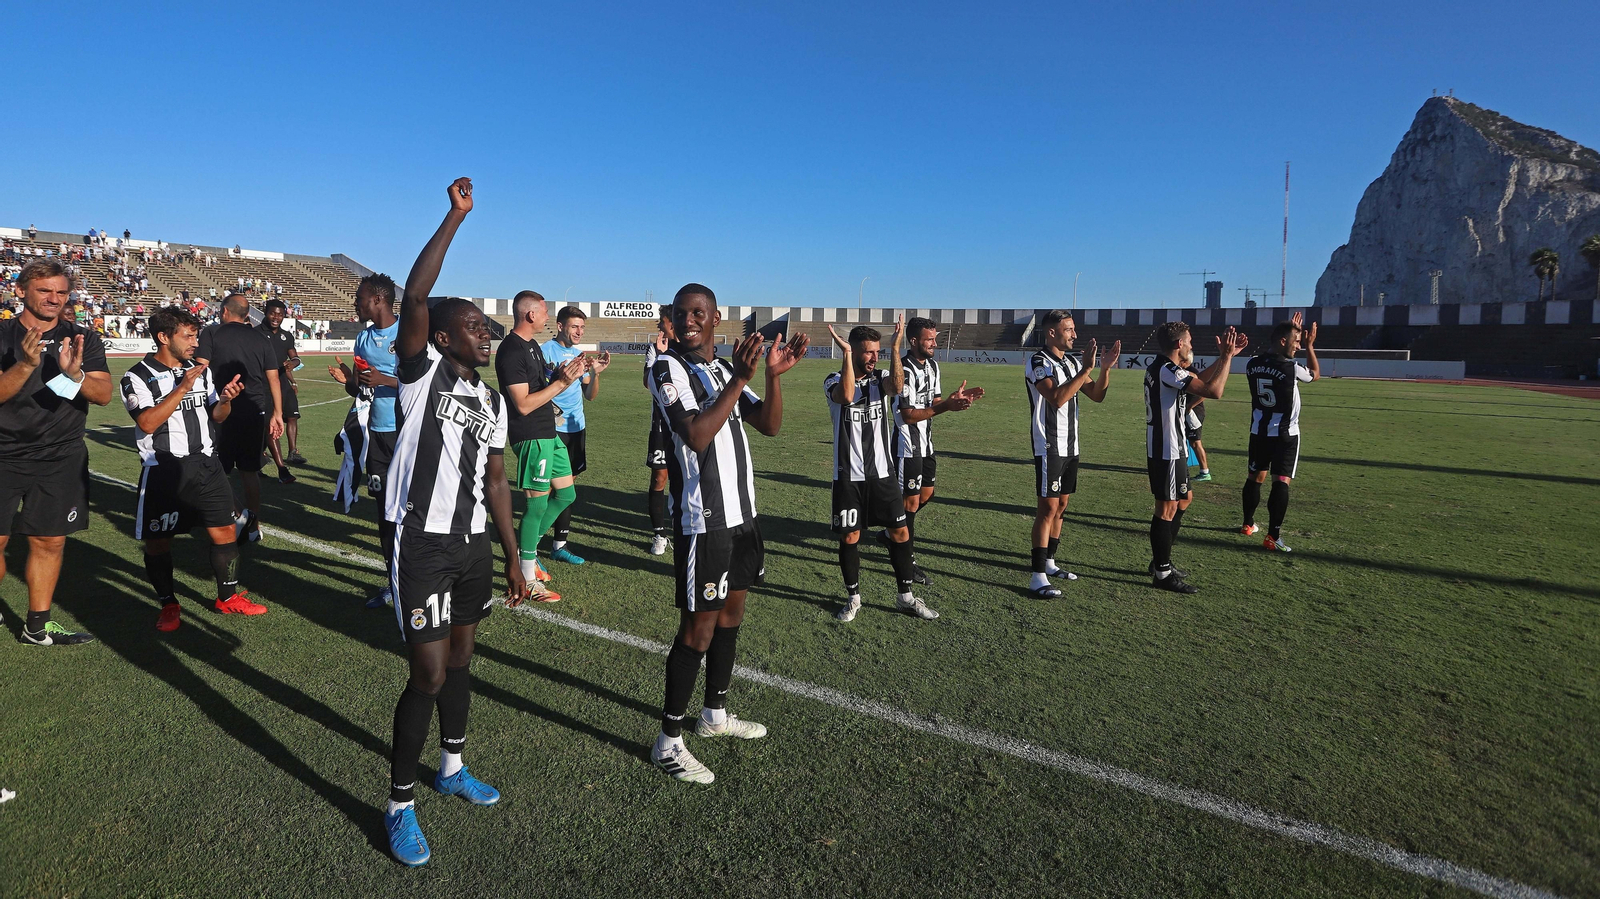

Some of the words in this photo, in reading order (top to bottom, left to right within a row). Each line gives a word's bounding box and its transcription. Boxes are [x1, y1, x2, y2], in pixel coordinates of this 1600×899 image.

[603, 310, 654, 318] GALLARDO
[606, 302, 653, 310] ALFREDO
[1256, 377, 1277, 408] 5
[844, 407, 883, 423] LOTUS
[538, 458, 547, 477] 1
[916, 474, 923, 490] 3
[161, 511, 179, 532] 19
[840, 508, 858, 528] 10
[717, 570, 729, 600] 6
[425, 591, 451, 628] 14
